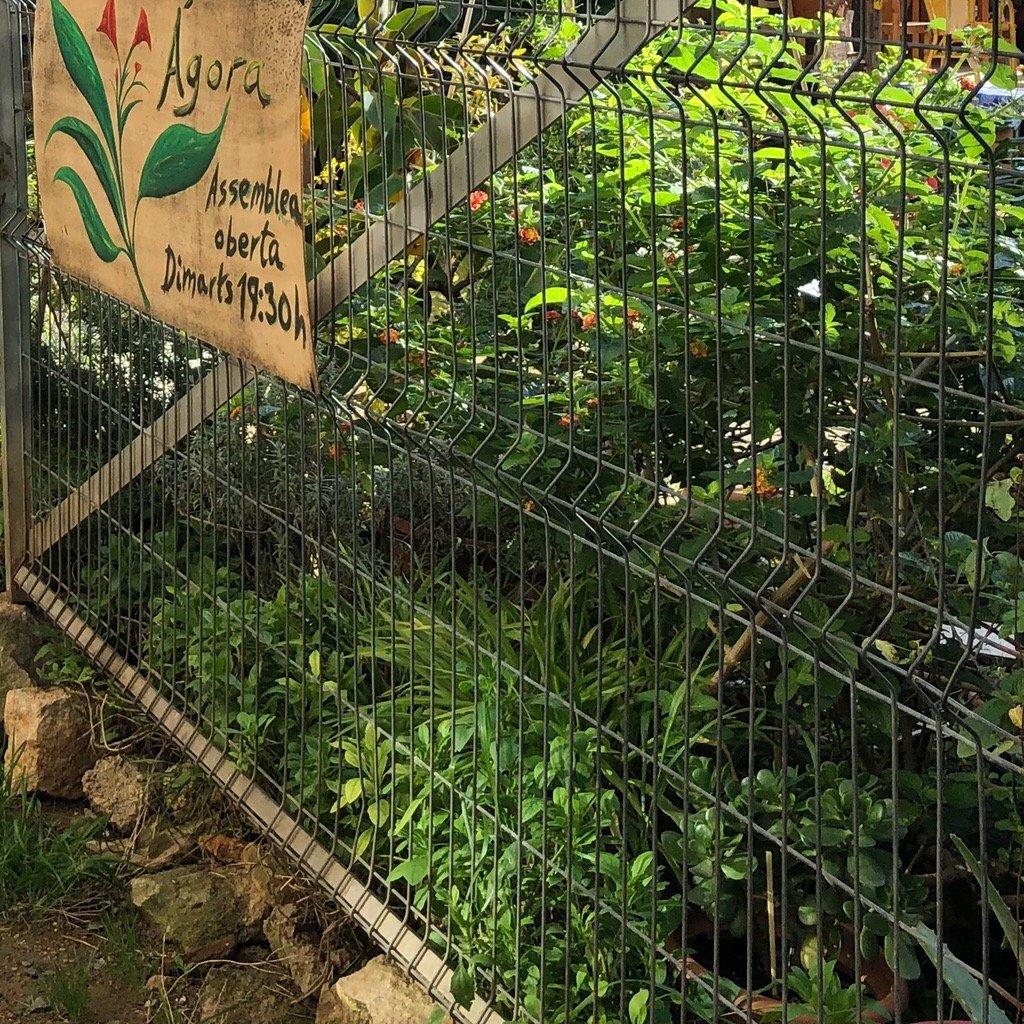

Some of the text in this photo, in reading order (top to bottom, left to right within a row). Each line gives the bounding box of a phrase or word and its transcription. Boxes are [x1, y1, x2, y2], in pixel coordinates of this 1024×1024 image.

[205, 162, 303, 227] Assemblea
[214, 216, 285, 272] oberta
[160, 245, 307, 350] Dimarts 19:30h
